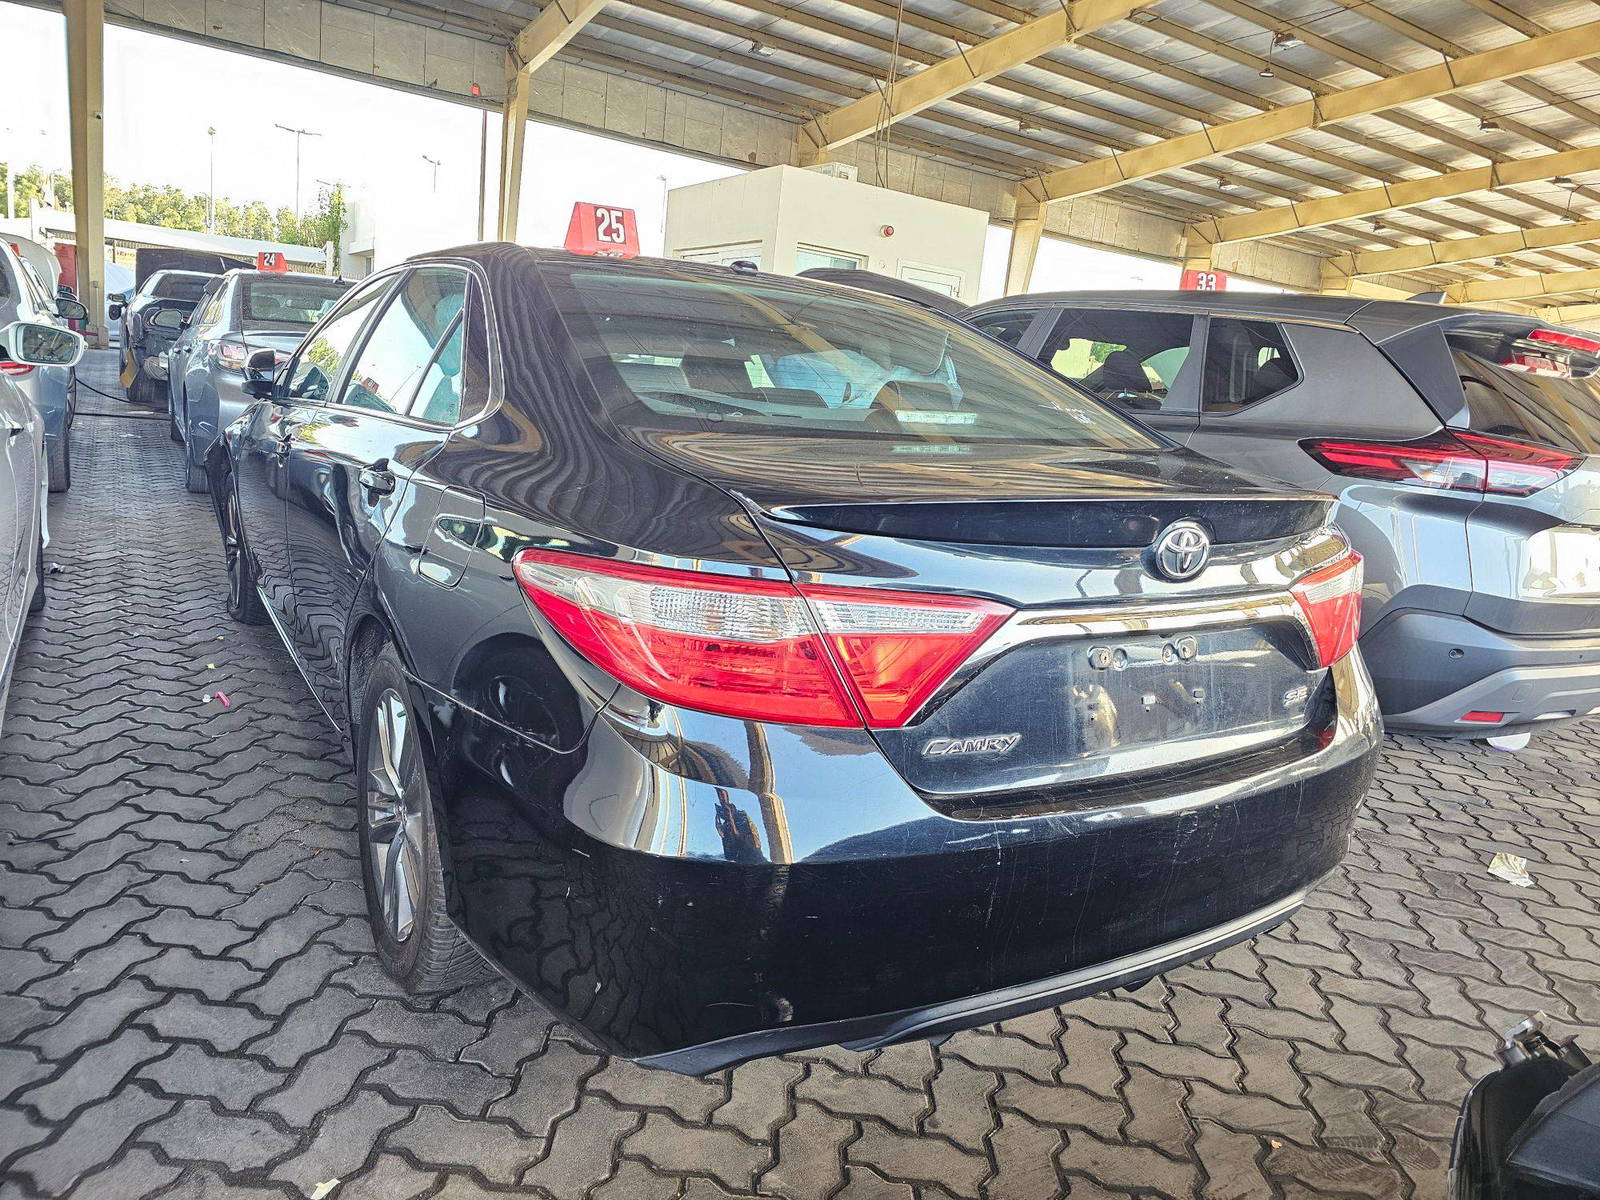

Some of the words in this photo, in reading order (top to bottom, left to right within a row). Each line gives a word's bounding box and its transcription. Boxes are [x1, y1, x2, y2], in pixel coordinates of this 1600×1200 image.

[596, 207, 625, 244] 25
[264, 253, 276, 266] 24
[1197, 272, 1217, 291] 33
[1283, 686, 1308, 706] SE
[921, 733, 1022, 757] CAMRY
